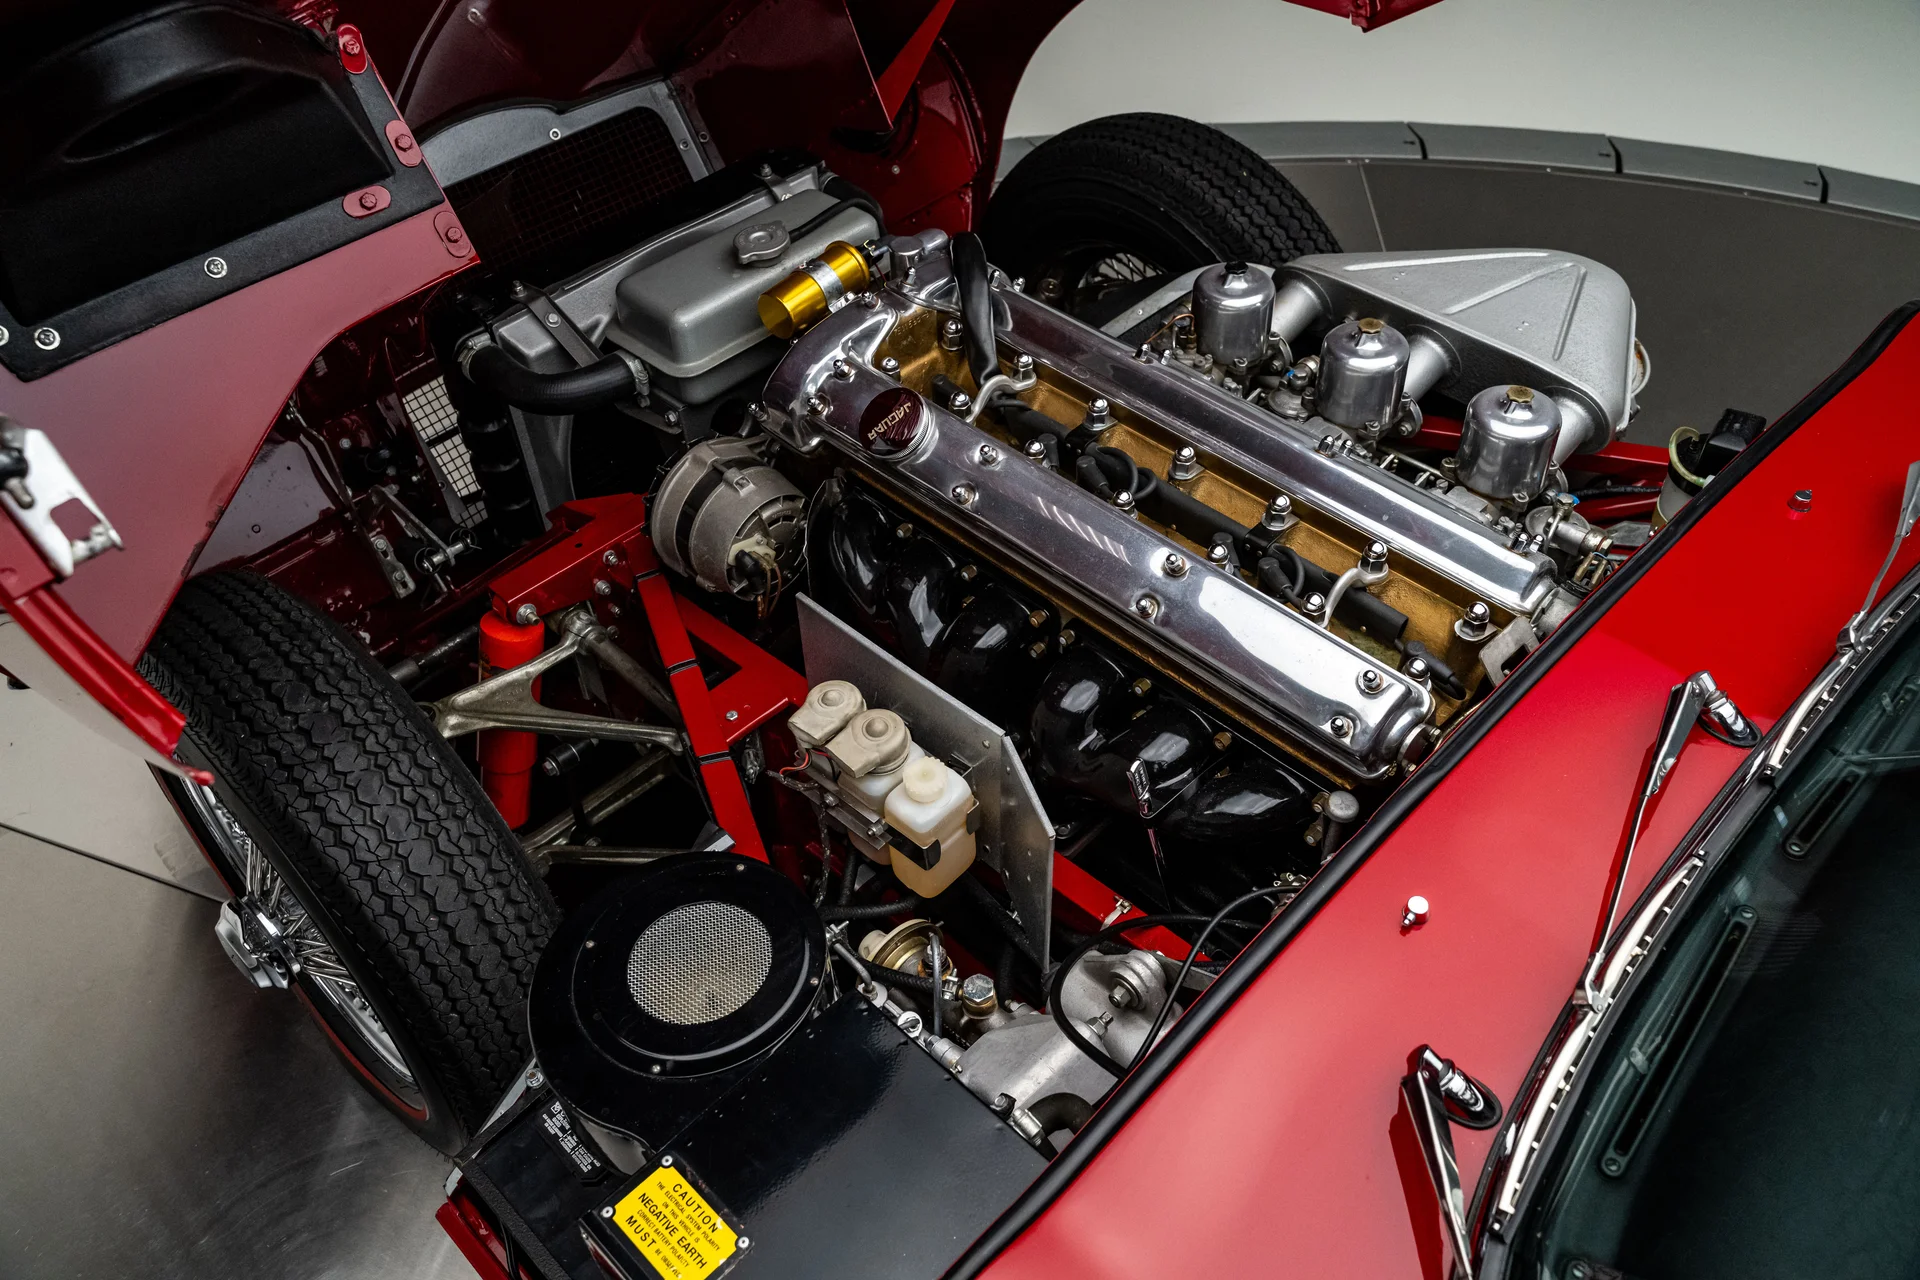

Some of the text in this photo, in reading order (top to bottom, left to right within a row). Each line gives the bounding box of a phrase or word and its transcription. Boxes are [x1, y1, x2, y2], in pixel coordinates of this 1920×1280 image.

[867, 402, 911, 440] JAGUAR
[657, 1181, 720, 1251] THE ELECTRICAL SYSTEM POLARITY
[669, 1210, 679, 1219] THIS
[679, 1219, 696, 1237] VEHICLE
[673, 1183, 718, 1233] CAUTION
[626, 1216, 656, 1248] MUST
[637, 1210, 656, 1229] CORRECT
[654, 1228, 670, 1247] BATTERY
[638, 1193, 707, 1269] NEGATIVE EARTH
